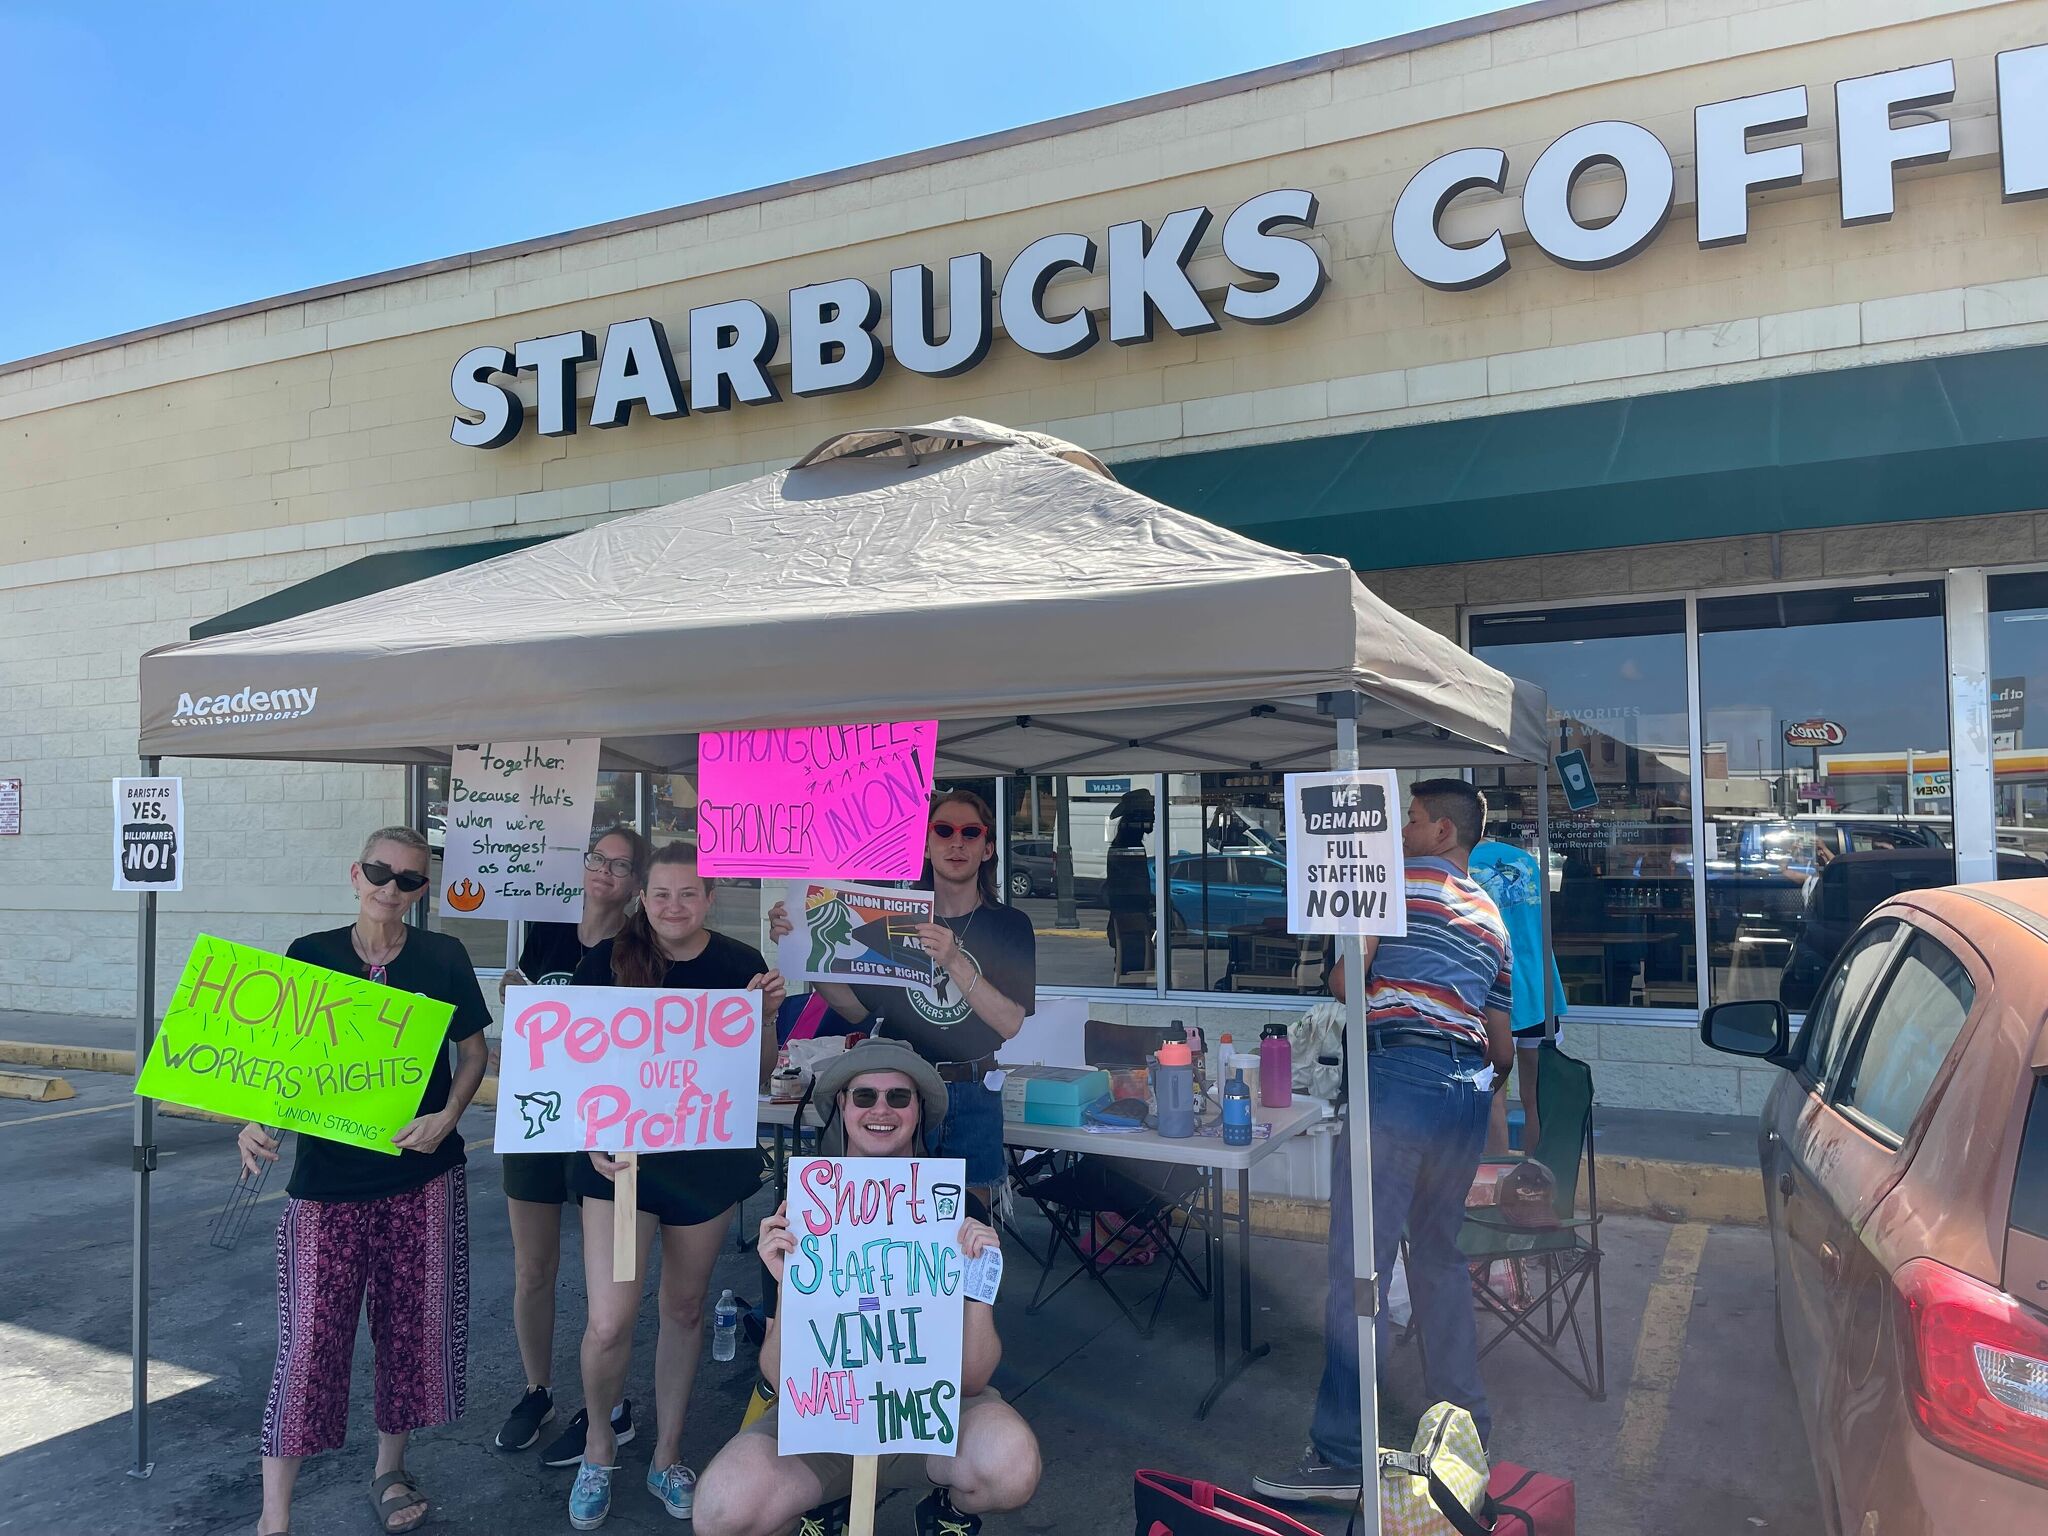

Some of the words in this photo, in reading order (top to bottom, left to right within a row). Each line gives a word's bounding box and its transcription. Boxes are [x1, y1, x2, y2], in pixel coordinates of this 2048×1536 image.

[449, 188, 1326, 450] STARBUCKS
[172, 685, 318, 717] Academy
[1554, 706, 1641, 720] FAVORITES
[480, 742, 565, 777] together.
[127, 787, 171, 799] BARISTAS
[451, 778, 521, 803] Because
[529, 785, 574, 807] that's
[1331, 790, 1359, 808] WE
[131, 801, 167, 822] YES,
[455, 810, 493, 829] when
[505, 814, 546, 832] we're
[1310, 810, 1382, 830] DEMAND
[124, 831, 174, 841] BILLIONAIRES
[698, 798, 815, 857] STRONGER
[1567, 828, 1591, 839] order
[127, 843, 170, 870] NO!
[1327, 840, 1368, 859] FULL
[477, 863, 499, 875] as
[506, 860, 544, 875] one."
[1307, 864, 1386, 883] STAFFING
[535, 882, 584, 904] Bridger
[844, 892, 881, 910] UNION
[883, 899, 929, 915] RIGHTS
[1306, 890, 1387, 919] NOW!
[850, 960, 893, 976] LGBTQ+
[895, 966, 931, 985] RIGHTS
[188, 956, 353, 1047] HONK
[377, 998, 415, 1049] 4
[911, 989, 944, 1019] ORKERS
[514, 991, 755, 1071] People
[315, 1056, 423, 1096] RIGHTS
[639, 1059, 698, 1090] OVER
[576, 1084, 734, 1149] Profit
[799, 1159, 927, 1236] Short
